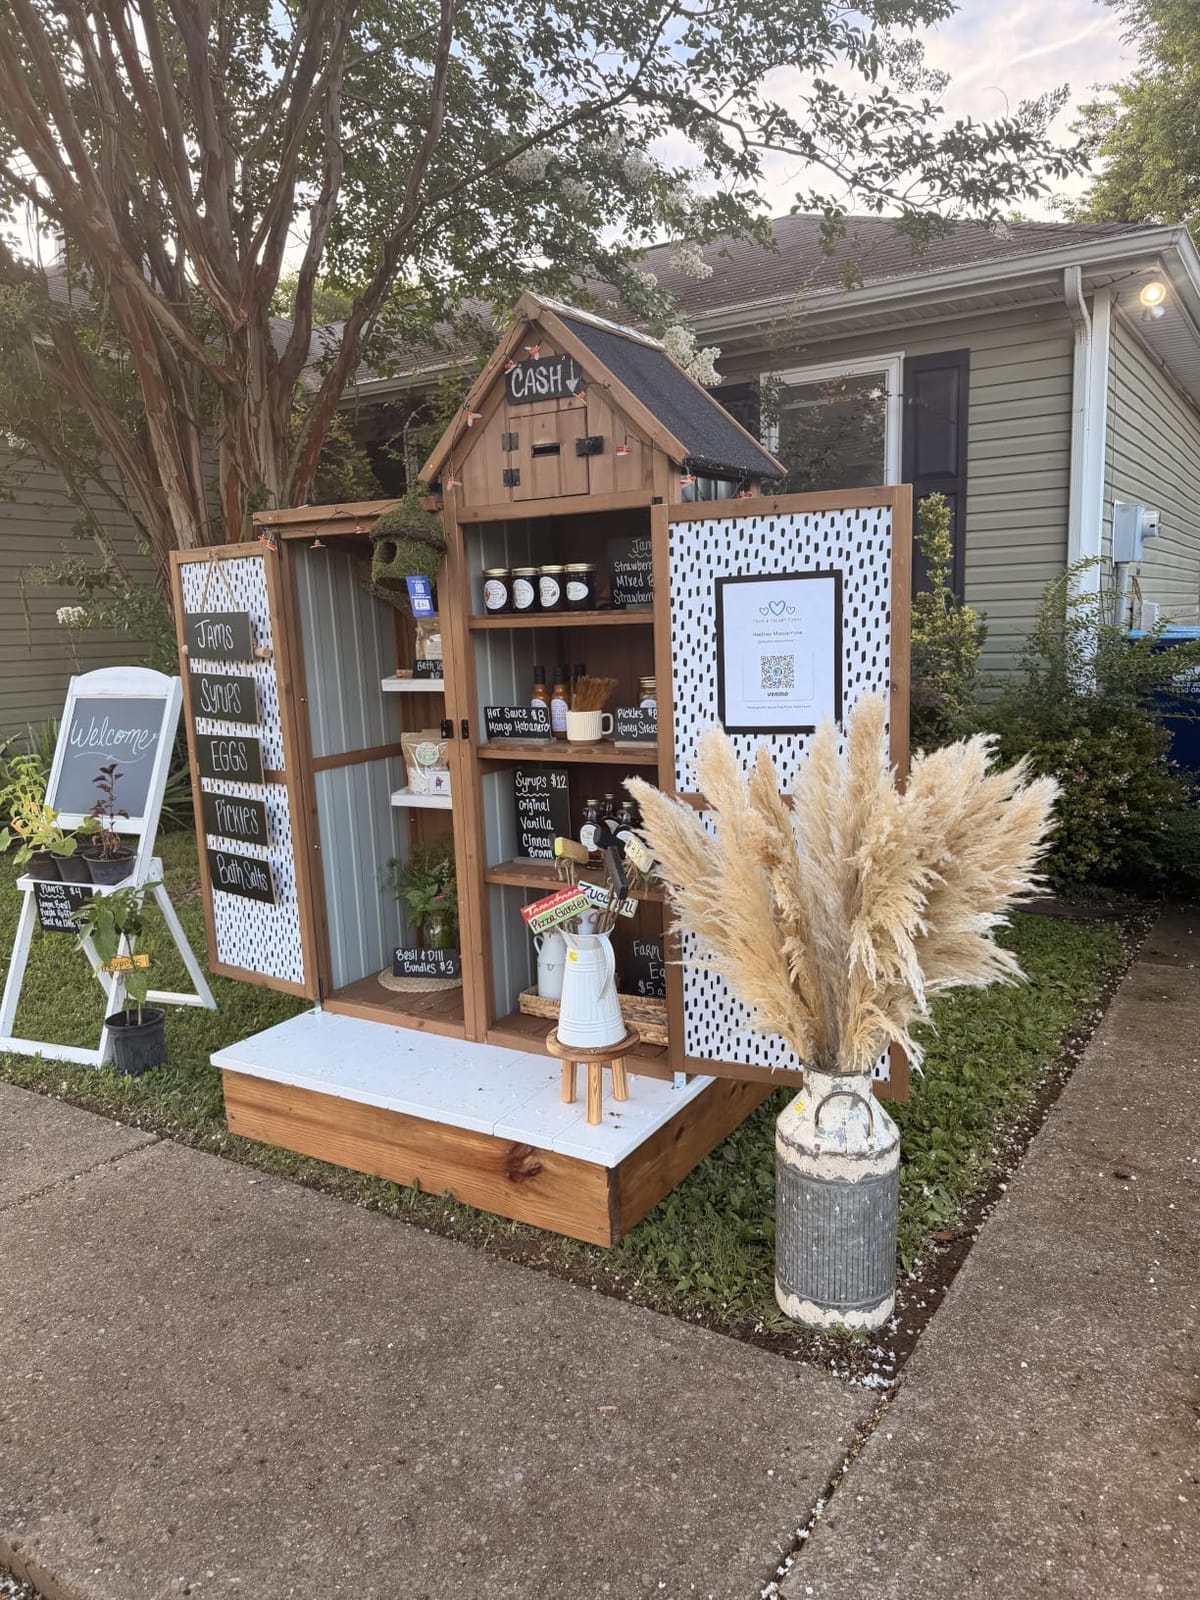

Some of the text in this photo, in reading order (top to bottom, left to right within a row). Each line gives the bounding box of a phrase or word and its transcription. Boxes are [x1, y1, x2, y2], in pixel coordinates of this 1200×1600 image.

[511, 363, 562, 398] CASH
[614, 560, 653, 573] Strawberr
[613, 589, 654, 605] Strawberr
[504, 707, 528, 719] Sauce
[530, 709, 546, 723] $8
[617, 707, 643, 719] Pickles
[70, 715, 158, 755] Welcome
[488, 721, 513, 736] Mango
[210, 740, 248, 772] EGGS
[515, 771, 568, 793] Syrups $12
[520, 815, 555, 831] Vanilla
[522, 833, 551, 847] Cinna
[528, 847, 553, 858] Brown
[216, 852, 269, 892] Bath Salts
[69, 886, 83, 899] $4
[531, 896, 591, 931] Pizza Garden
[396, 949, 417, 961] Basil
[427, 950, 443, 961] Dill
[403, 960, 453, 974] Bundles $3
[648, 961, 667, 987] Eg
[638, 979, 655, 996] $5
